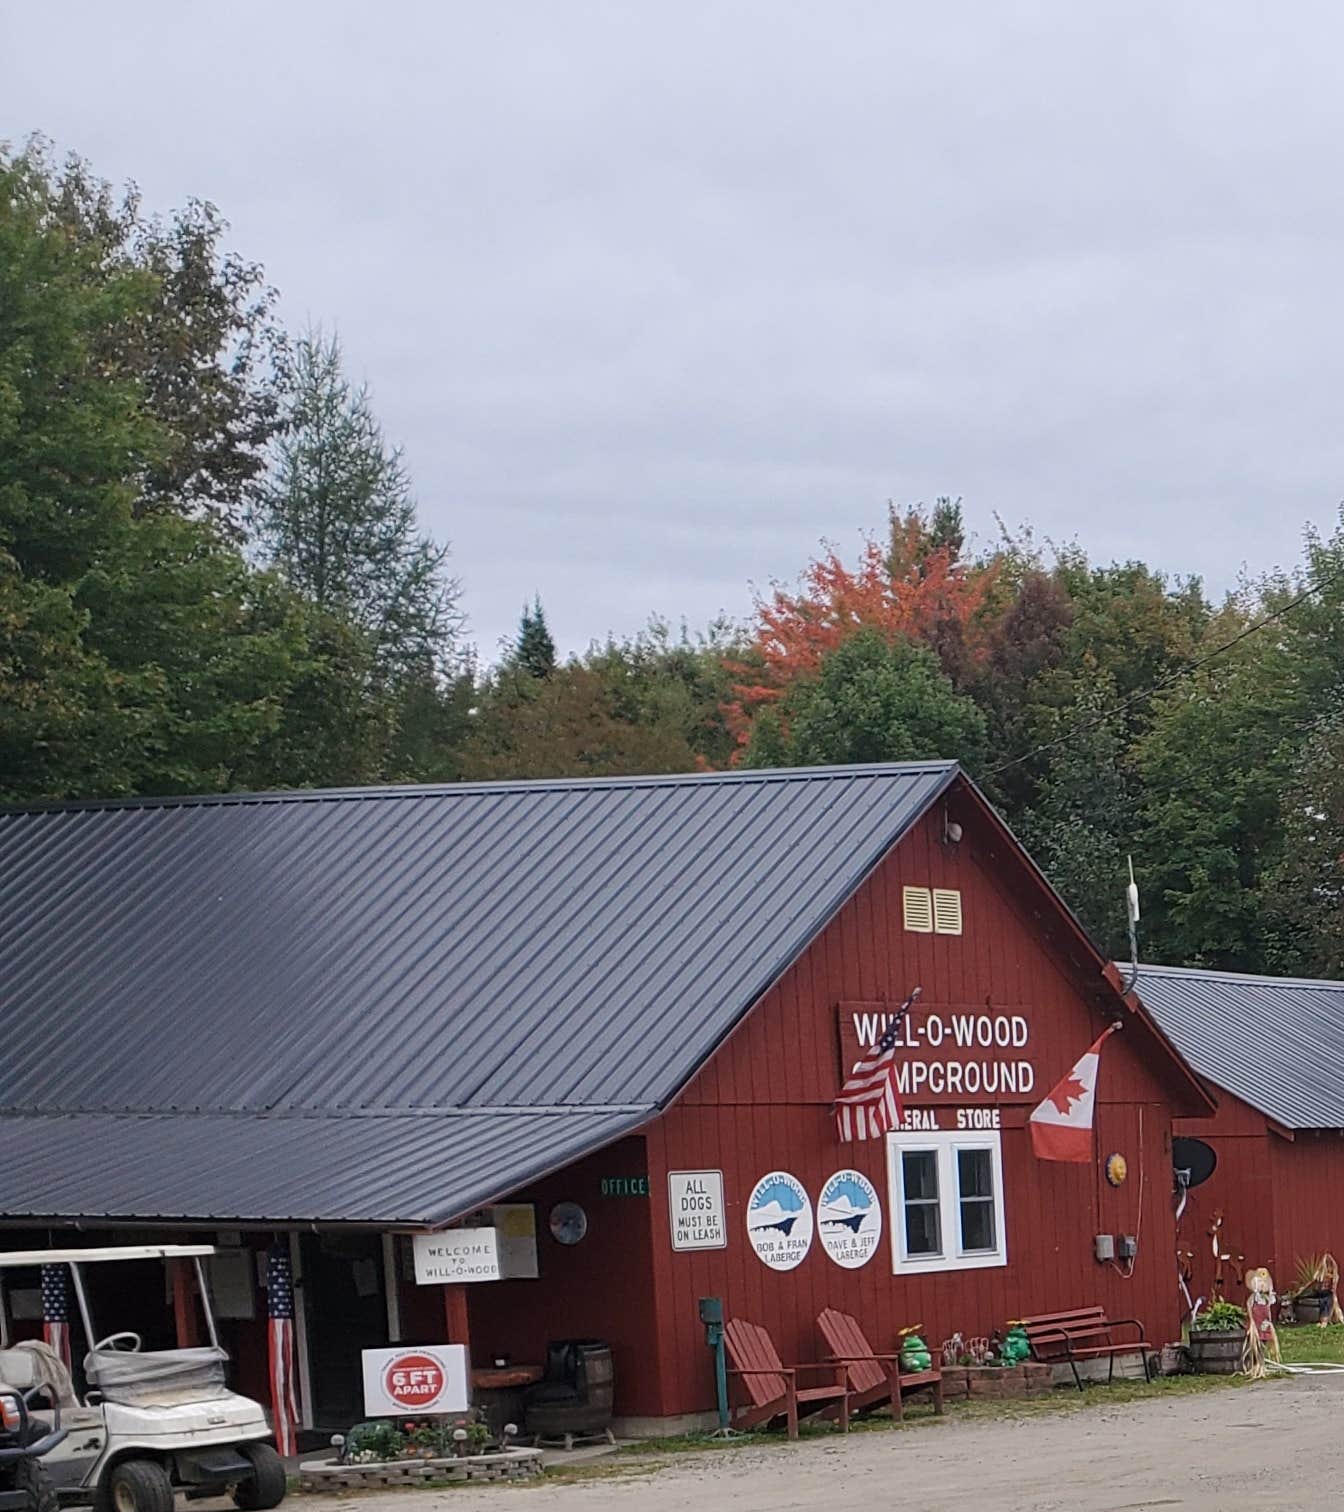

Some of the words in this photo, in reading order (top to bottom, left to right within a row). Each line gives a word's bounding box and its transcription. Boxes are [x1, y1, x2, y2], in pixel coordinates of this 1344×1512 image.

[852, 1061, 1034, 1094] MPGROUND
[957, 1109, 1000, 1129] STORE
[601, 1178, 646, 1195] OFFICE
[686, 1179, 707, 1194] ALL
[681, 1196, 712, 1211] DOGS
[678, 1215, 702, 1228] MUST
[706, 1215, 718, 1226] BE
[677, 1230, 689, 1241] ON
[693, 1229, 721, 1240] LEASH
[756, 1241, 775, 1253] BOB
[787, 1239, 808, 1250] FRAN
[828, 1239, 848, 1250] DAVE
[860, 1236, 875, 1247] JEFF
[428, 1245, 491, 1257] WELCOME
[452, 1257, 465, 1265] TO
[425, 1265, 497, 1278] WILL-O-WOOD
[392, 1372, 406, 1386] 6
[410, 1370, 436, 1385] FT
[394, 1384, 438, 1396] APART
